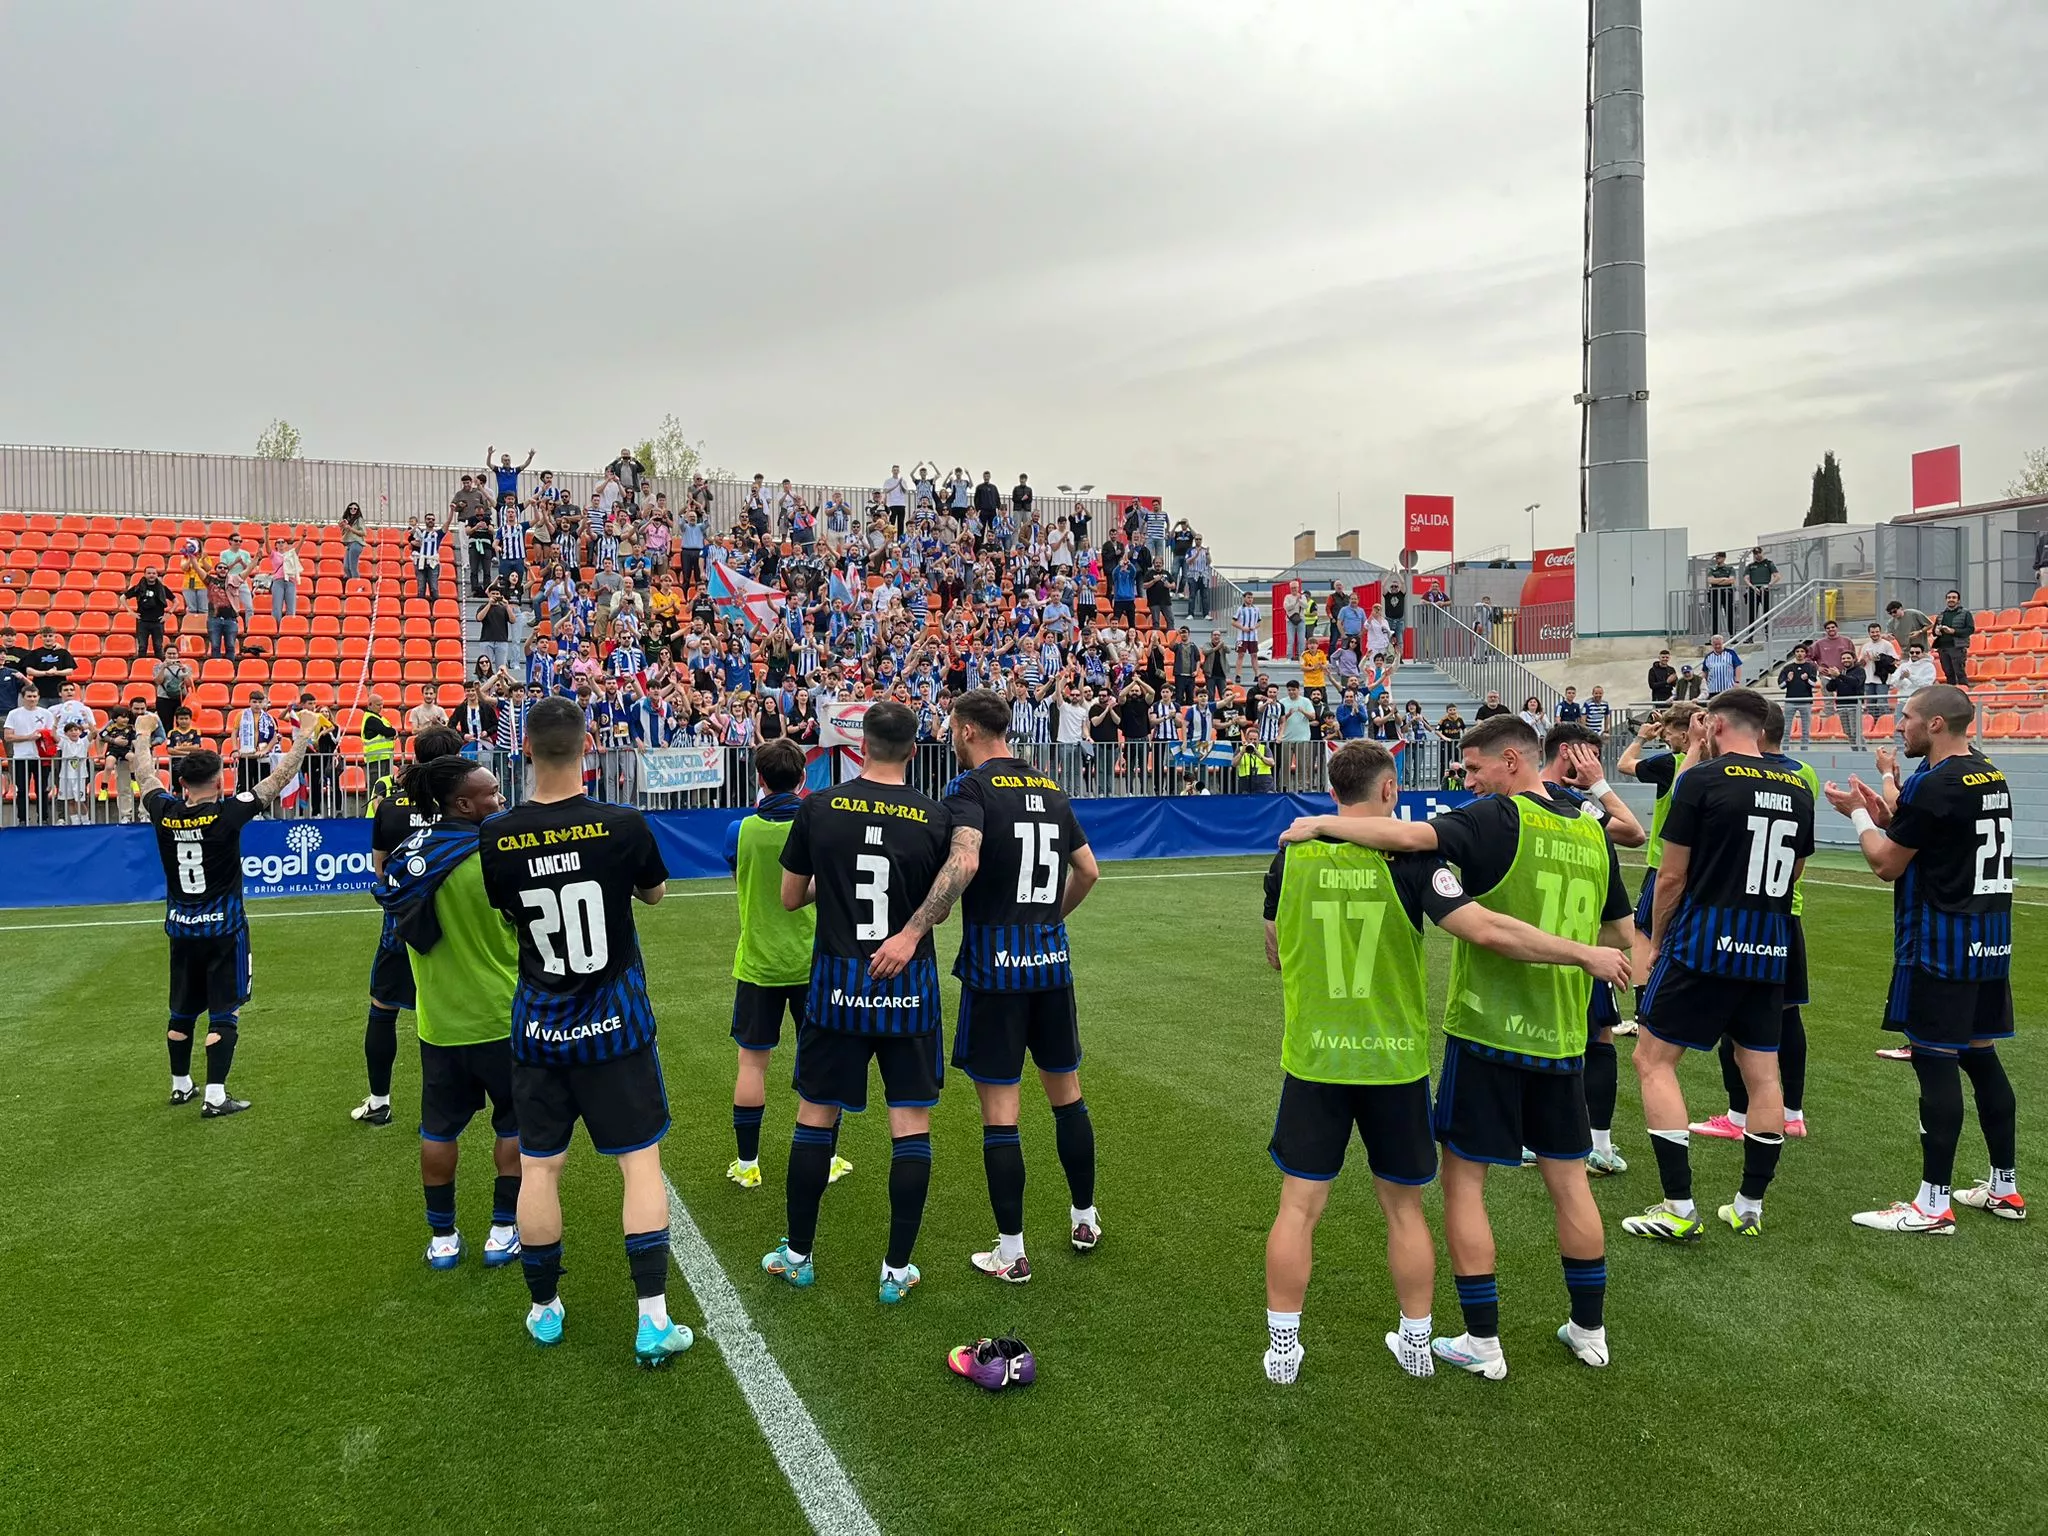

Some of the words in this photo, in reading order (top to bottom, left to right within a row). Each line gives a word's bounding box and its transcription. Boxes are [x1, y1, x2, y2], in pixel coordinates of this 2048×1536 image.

[1410, 513, 1449, 526] SALIDA
[991, 775, 1023, 788] CAJA
[1724, 766, 1762, 779] CAJA
[831, 797, 869, 813] CAJA
[1025, 794, 1046, 813] LEAL
[1754, 791, 1793, 813] MARKEL
[497, 832, 540, 851] CAJA
[864, 825, 883, 845] NIL
[1535, 837, 1548, 858] B.
[1746, 815, 1798, 898] 16
[1973, 817, 2013, 895] 22
[177, 842, 206, 894] 8
[241, 837, 308, 884] egal
[527, 851, 581, 877] LANCHO
[1013, 822, 1060, 904] 15
[254, 885, 284, 894] BRING
[289, 883, 332, 892] HEALTHY
[855, 854, 890, 941] 3
[518, 880, 609, 976] 20
[1532, 870, 1597, 974] 18
[1010, 950, 1069, 967] VALCARCE
[1311, 901, 1387, 999] 17
[1734, 942, 1788, 958] VALCARCE
[845, 995, 920, 1008] VALCARCE
[542, 1016, 622, 1042] VALCARCE
[1327, 1036, 1415, 1051] VALCARCE
